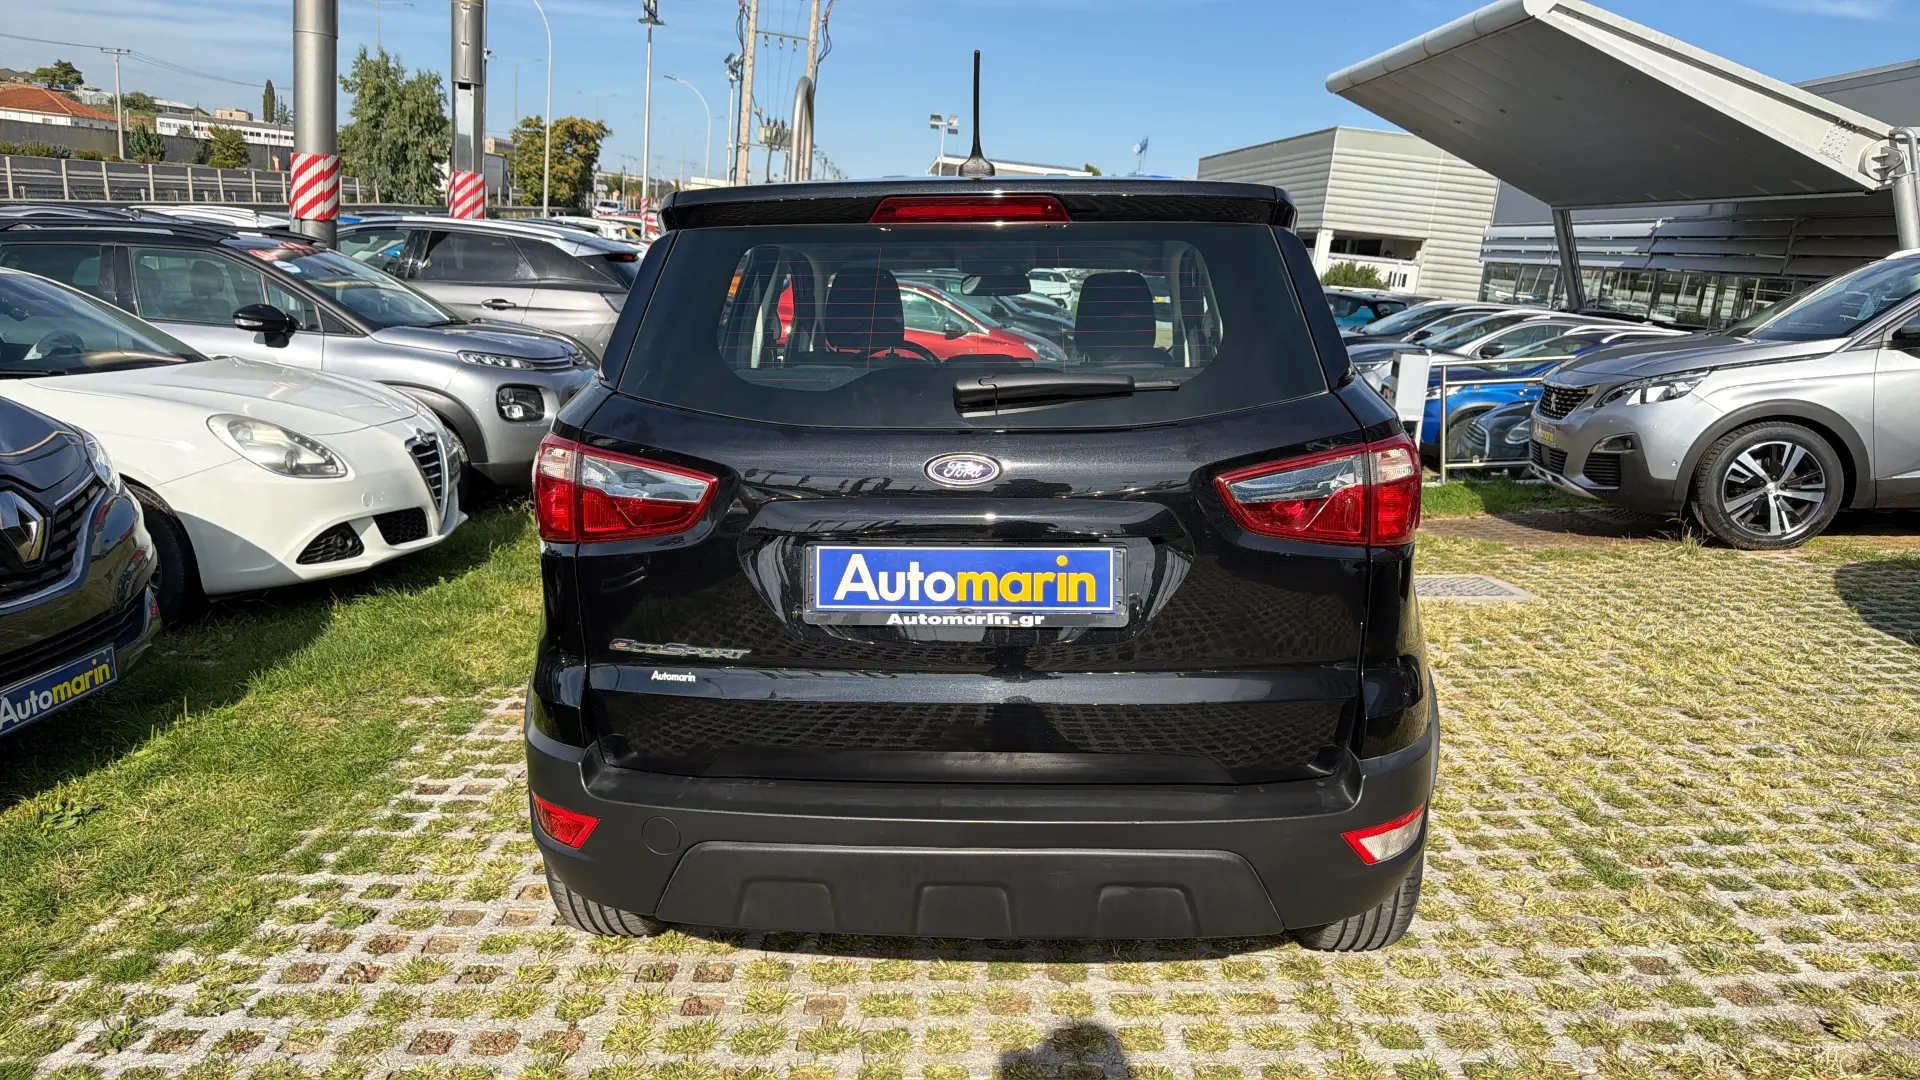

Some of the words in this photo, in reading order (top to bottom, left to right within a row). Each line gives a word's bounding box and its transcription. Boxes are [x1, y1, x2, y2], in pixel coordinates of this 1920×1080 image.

[943, 461, 983, 478] Ford
[833, 553, 1096, 603] Automarin
[886, 612, 1045, 628] Automarin.gr
[651, 669, 697, 682] Automarin
[0, 658, 111, 730] Automarin
